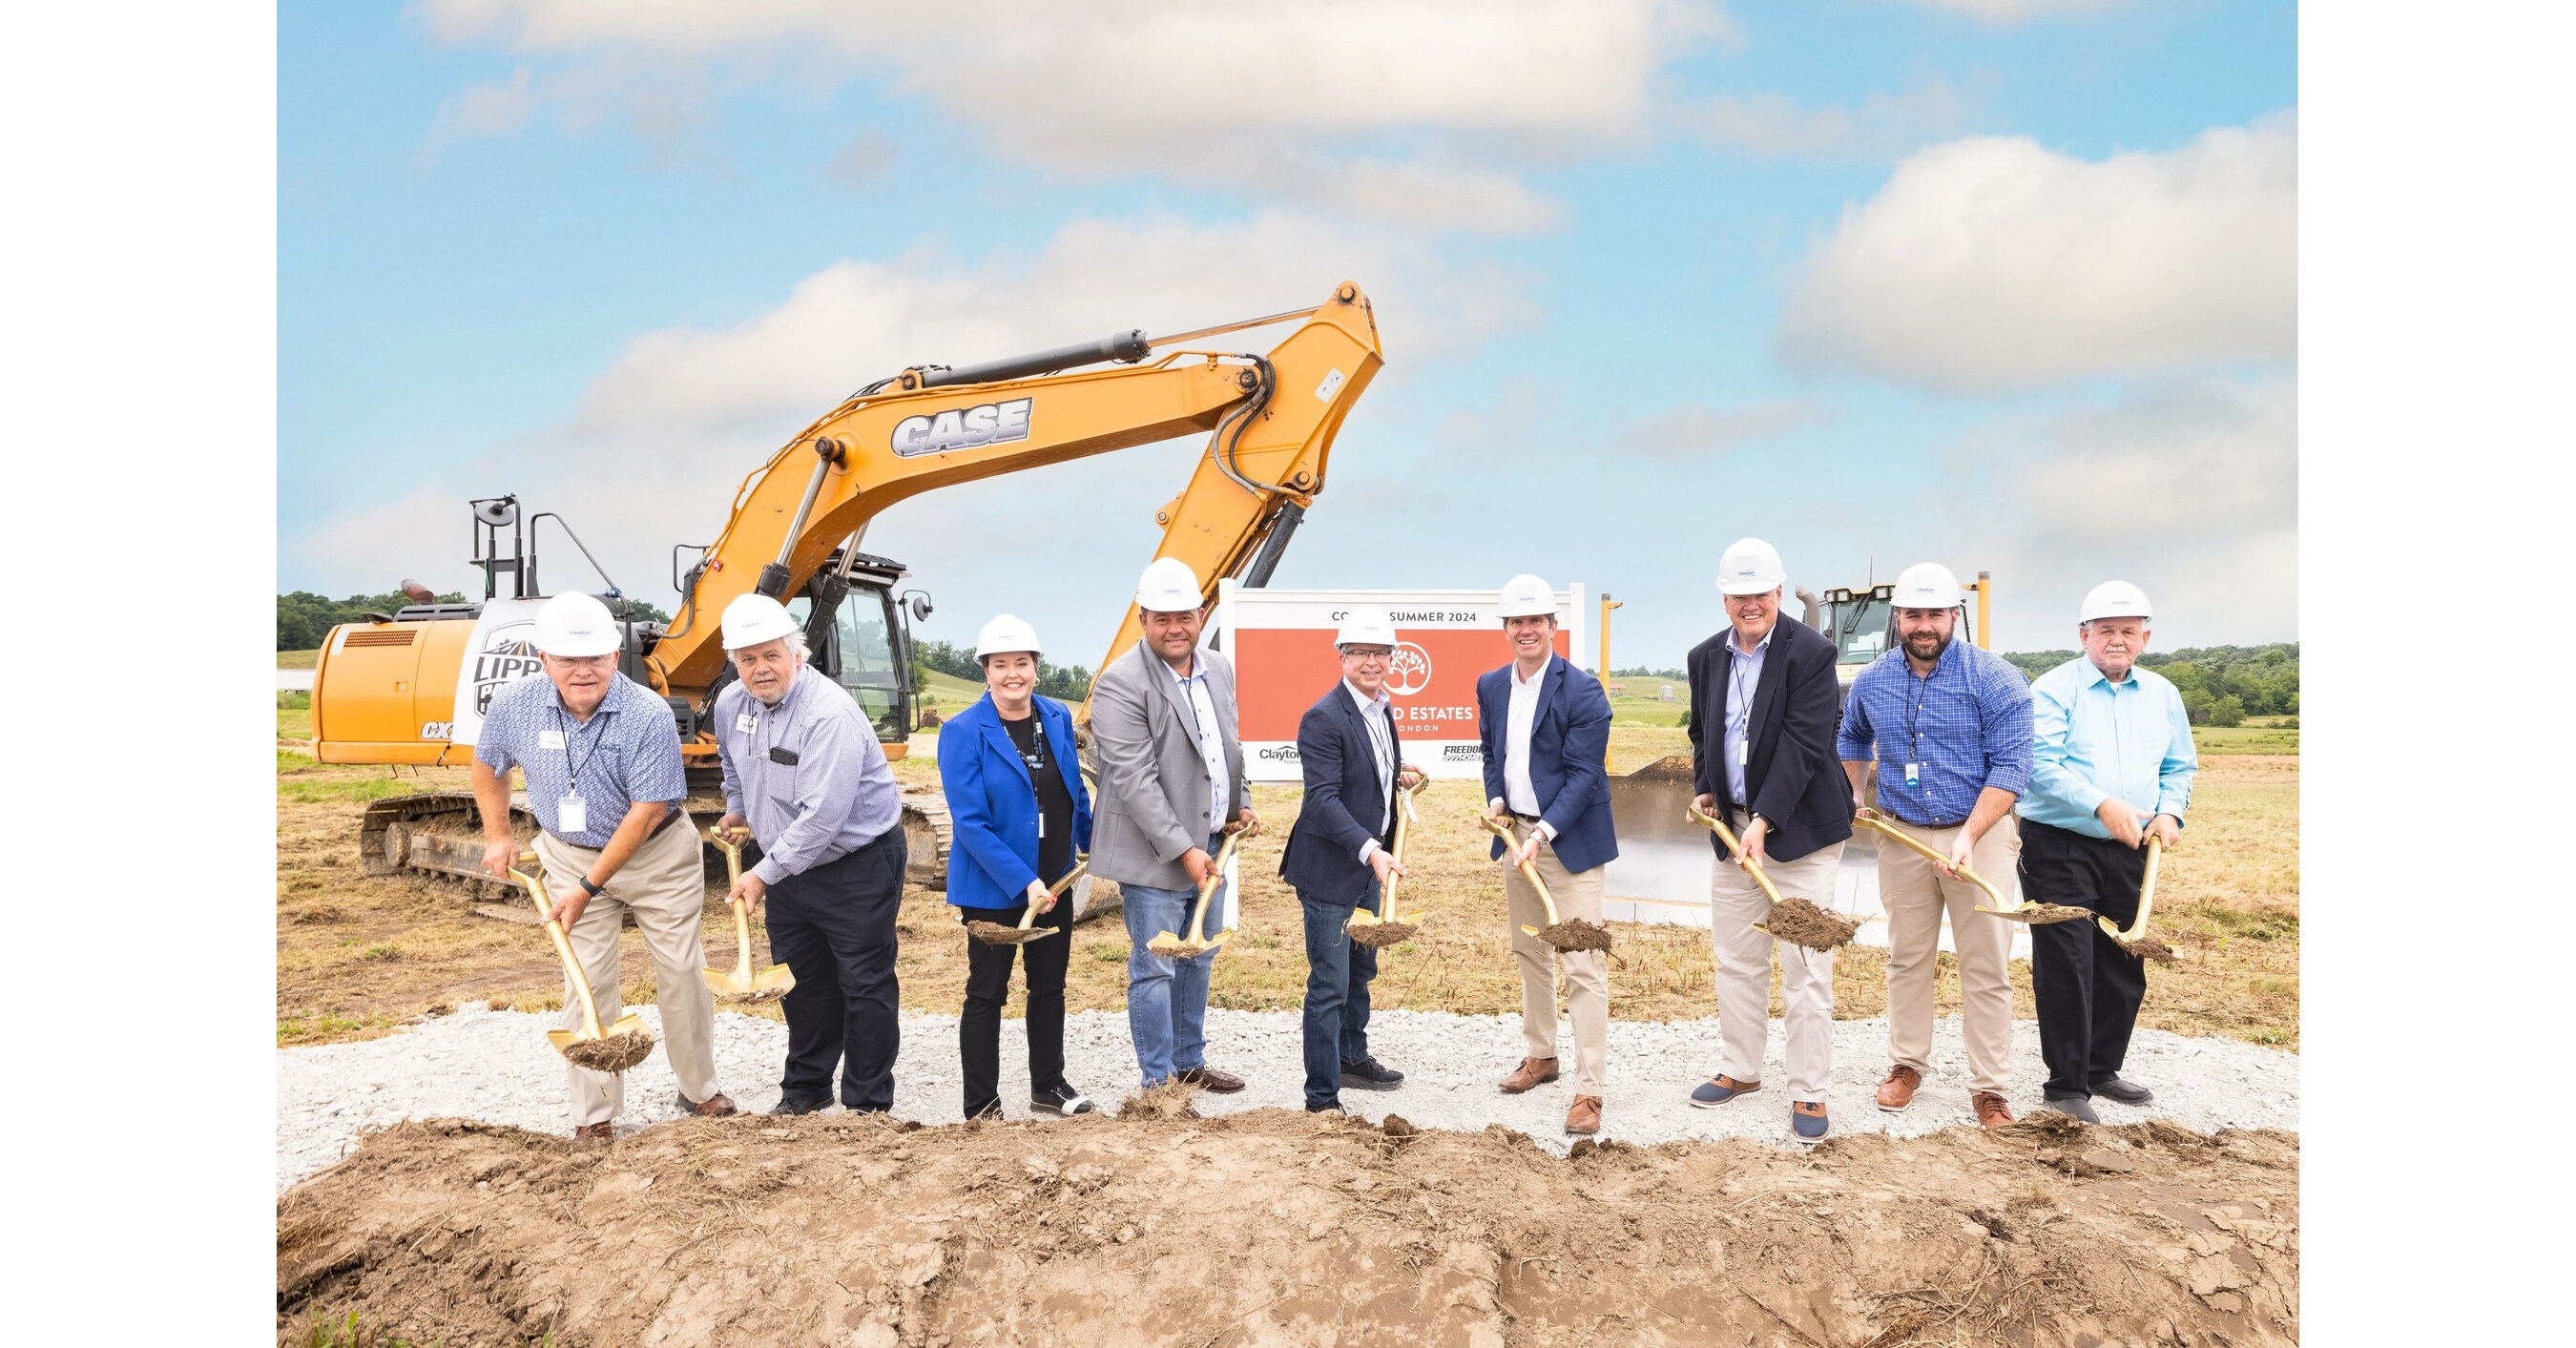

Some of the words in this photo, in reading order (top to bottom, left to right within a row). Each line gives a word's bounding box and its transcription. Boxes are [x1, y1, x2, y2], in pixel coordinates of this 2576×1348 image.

[892, 397, 1032, 457] CASE
[1389, 612, 1444, 622] SUMMER
[1448, 612, 1477, 622] 2024
[474, 656, 543, 683] LIPP
[1410, 707, 1473, 720] ESTATES
[1444, 745, 1481, 756] FREEDO
